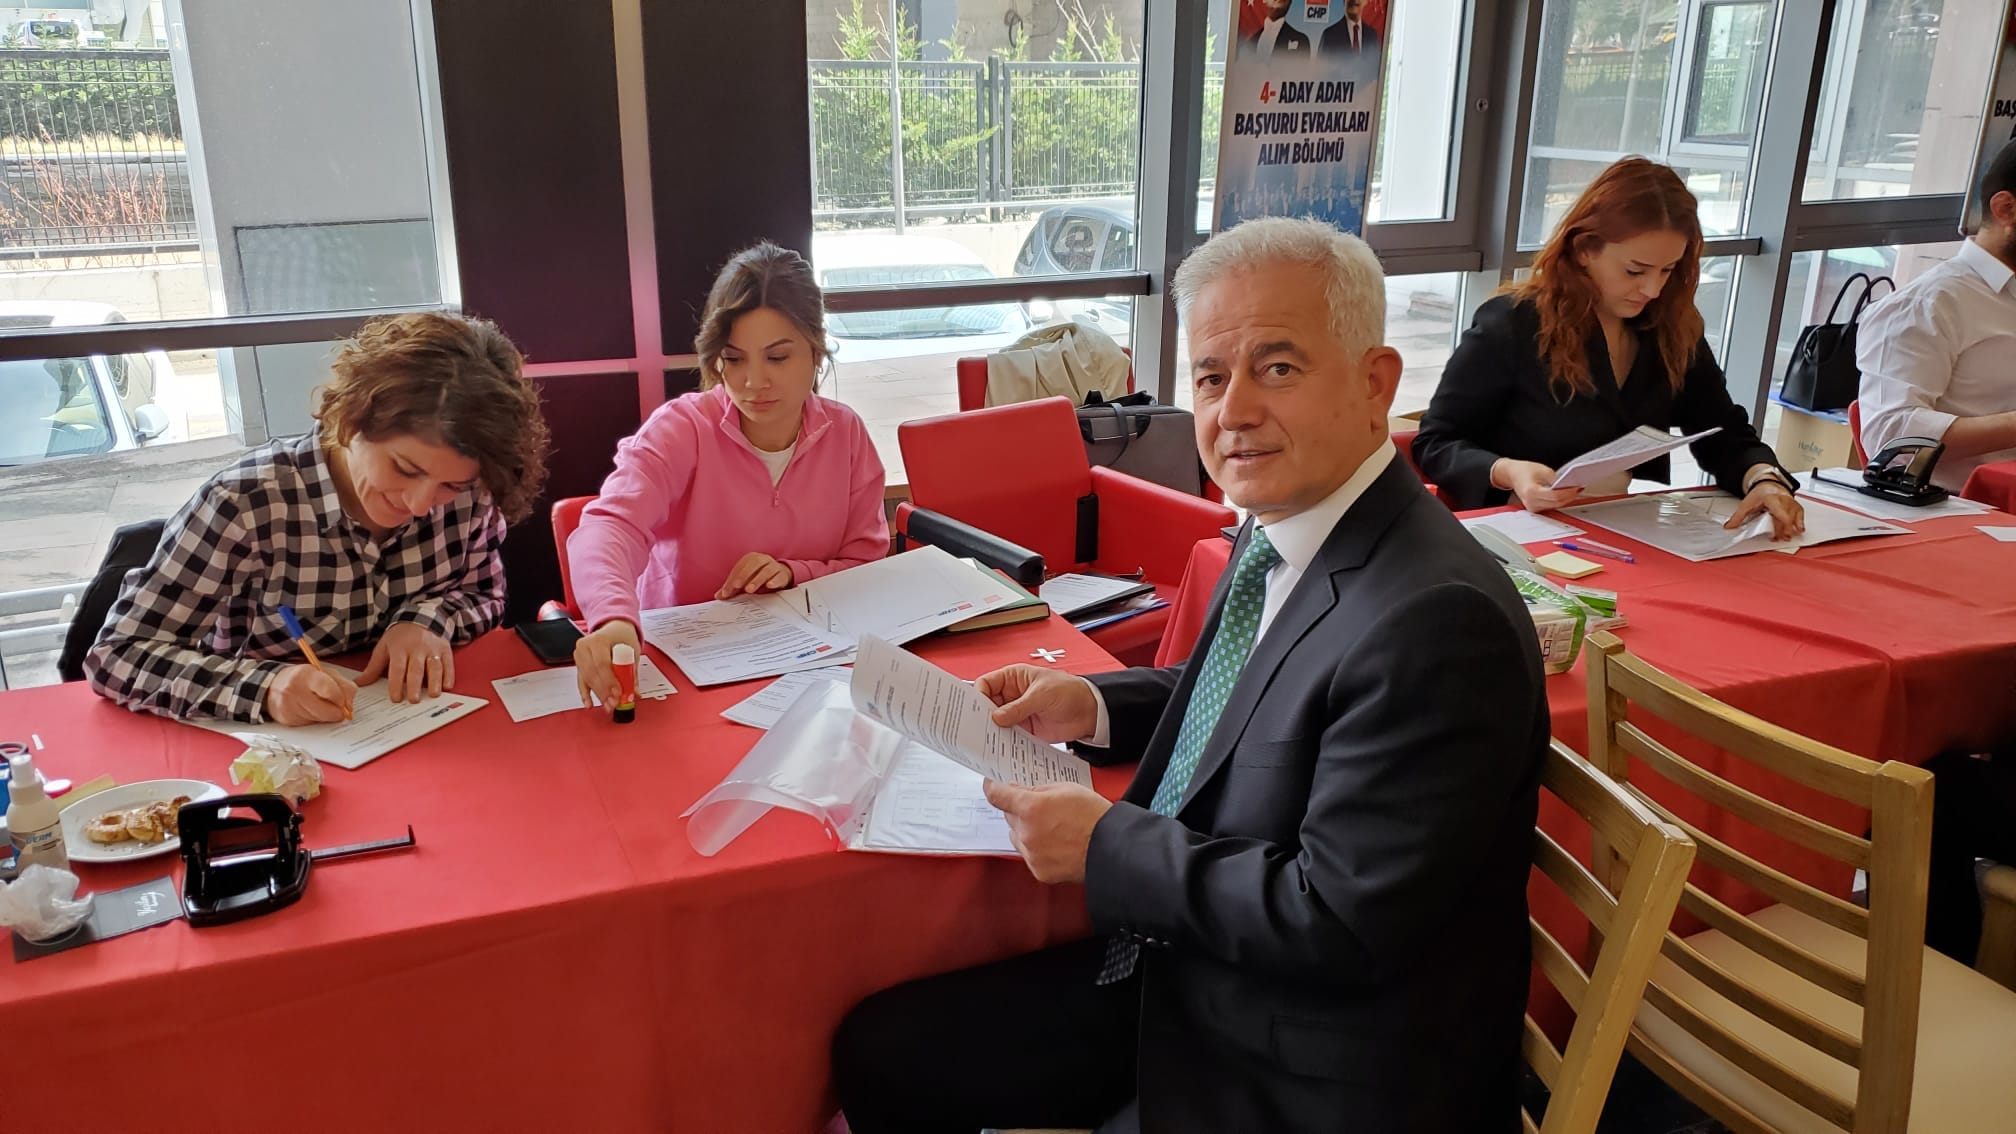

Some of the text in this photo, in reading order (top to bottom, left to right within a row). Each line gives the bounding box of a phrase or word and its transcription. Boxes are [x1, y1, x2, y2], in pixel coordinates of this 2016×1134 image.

[1307, 6, 1327, 18] CHP
[1260, 81, 1354, 104] 4- ADAY ADAYI
[1234, 111, 1370, 138] BAŞVURU EVRAKLARI
[1257, 137, 1345, 165] ALIM BÖLÜMÜ
